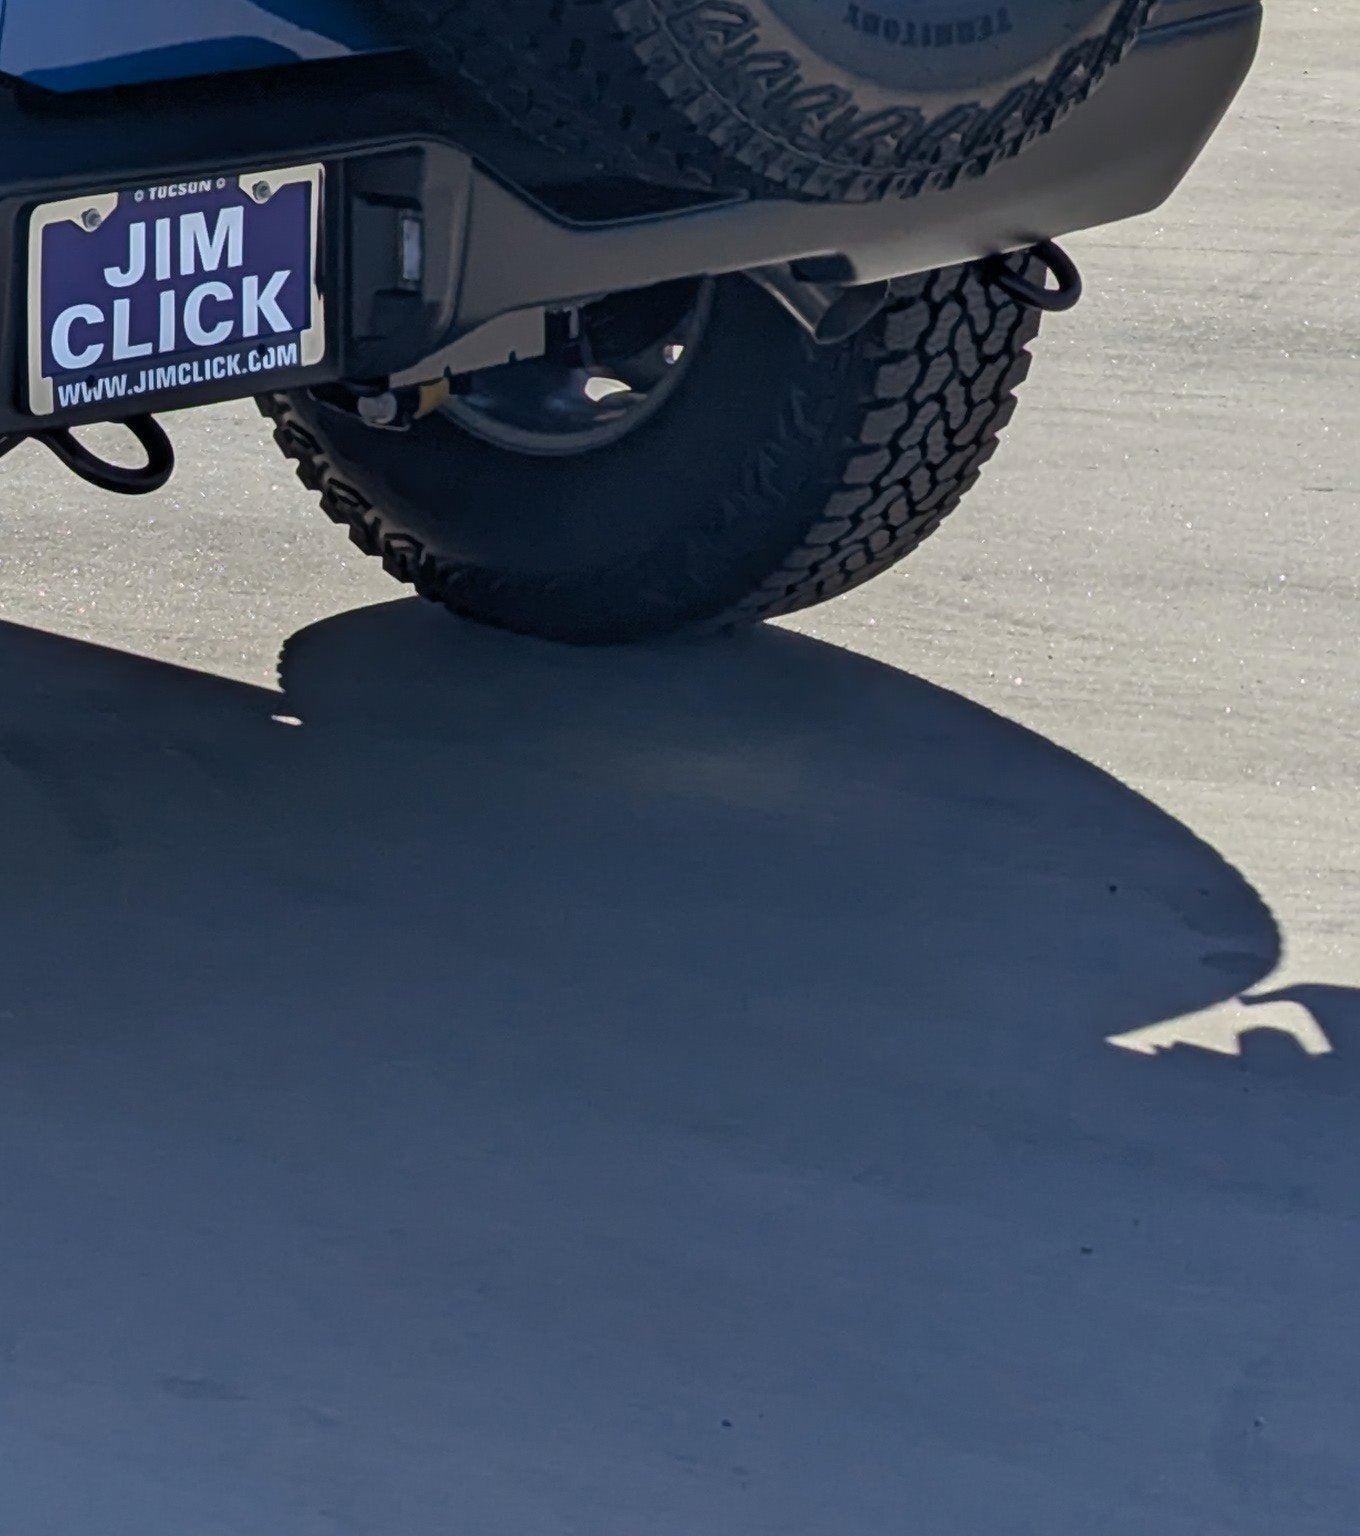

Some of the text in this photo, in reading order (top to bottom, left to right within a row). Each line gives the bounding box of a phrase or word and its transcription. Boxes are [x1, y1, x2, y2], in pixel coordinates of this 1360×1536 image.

[148, 179, 212, 200] TUCSON
[103, 205, 244, 288] JIM
[51, 270, 293, 369] CLICK
[57, 342, 298, 408] WWW.JIMCLICK.COM
